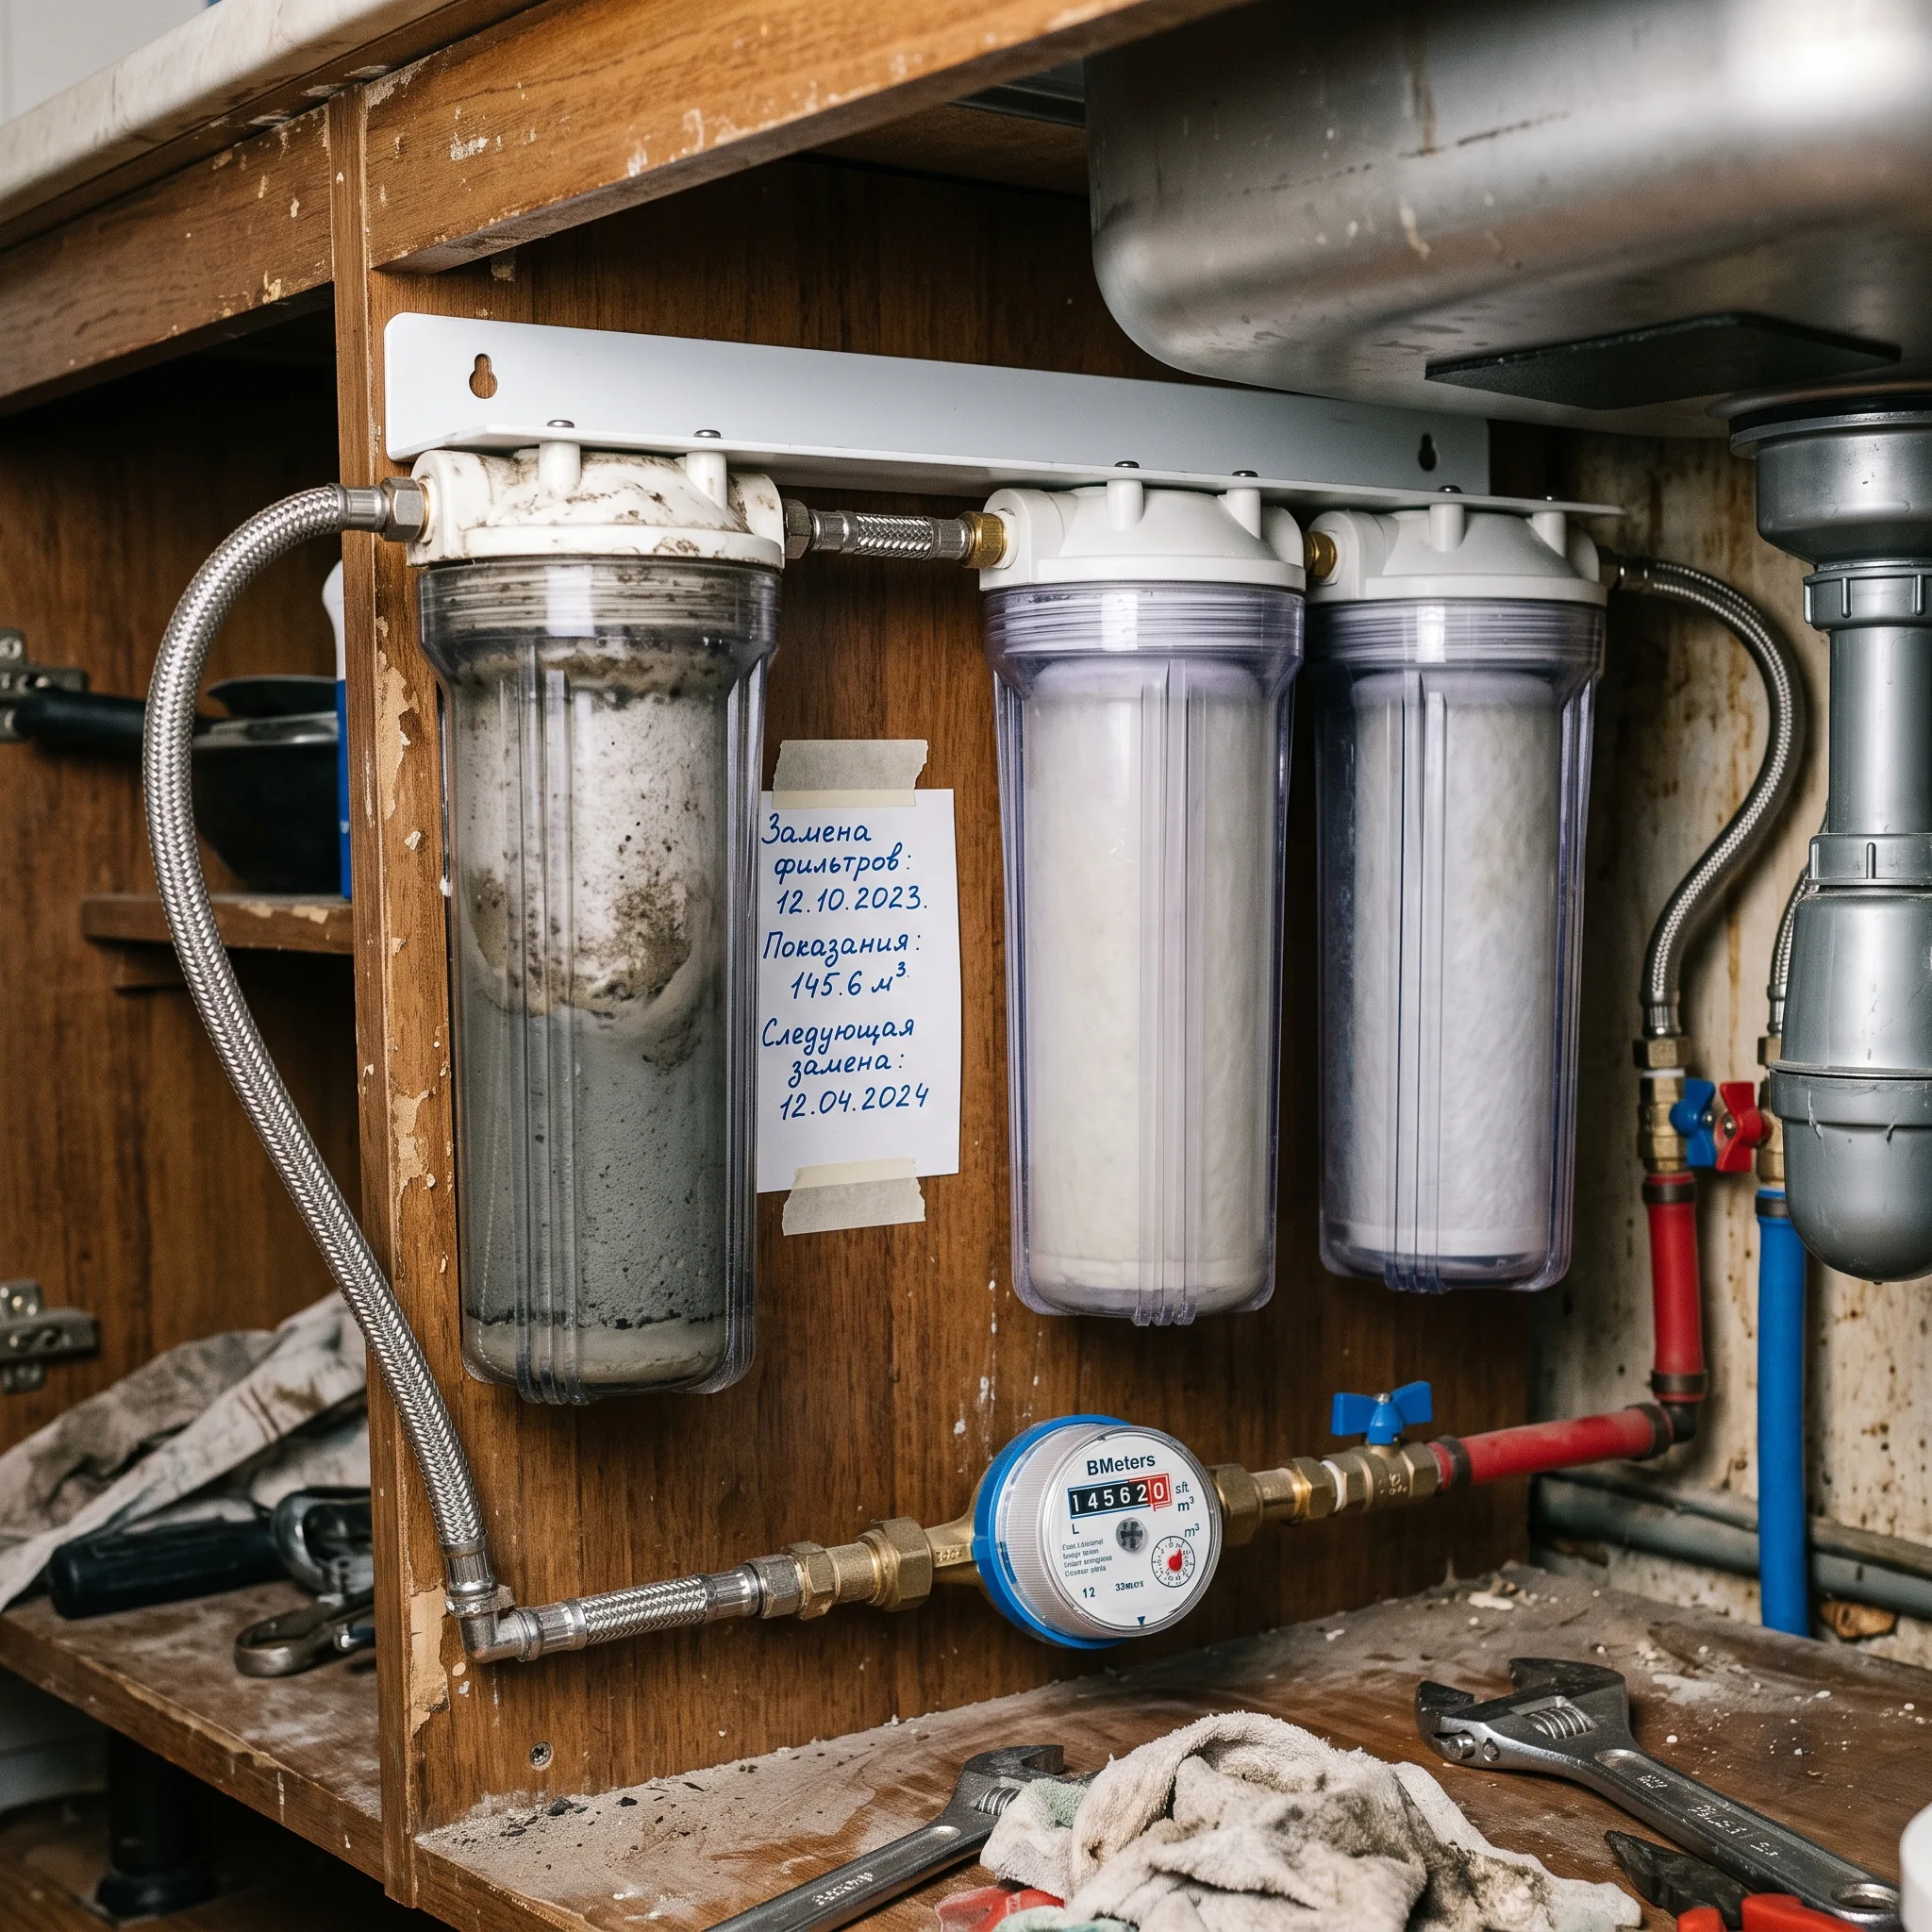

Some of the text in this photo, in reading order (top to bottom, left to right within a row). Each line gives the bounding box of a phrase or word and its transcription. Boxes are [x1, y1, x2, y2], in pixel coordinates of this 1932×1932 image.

[761, 813, 873, 845] Замена
[774, 841, 912, 886] фильтров:
[762, 931, 921, 969] Показания:
[791, 970, 863, 1000] 145.6
[761, 1018, 915, 1058] Следующая
[787, 1054, 906, 1089] замена:
[779, 1082, 929, 1121] 12.04.2024
[1086, 1455, 1157, 1476] BMeters
[1072, 1524, 1080, 1535] L
[1082, 1587, 1096, 1599] 12
